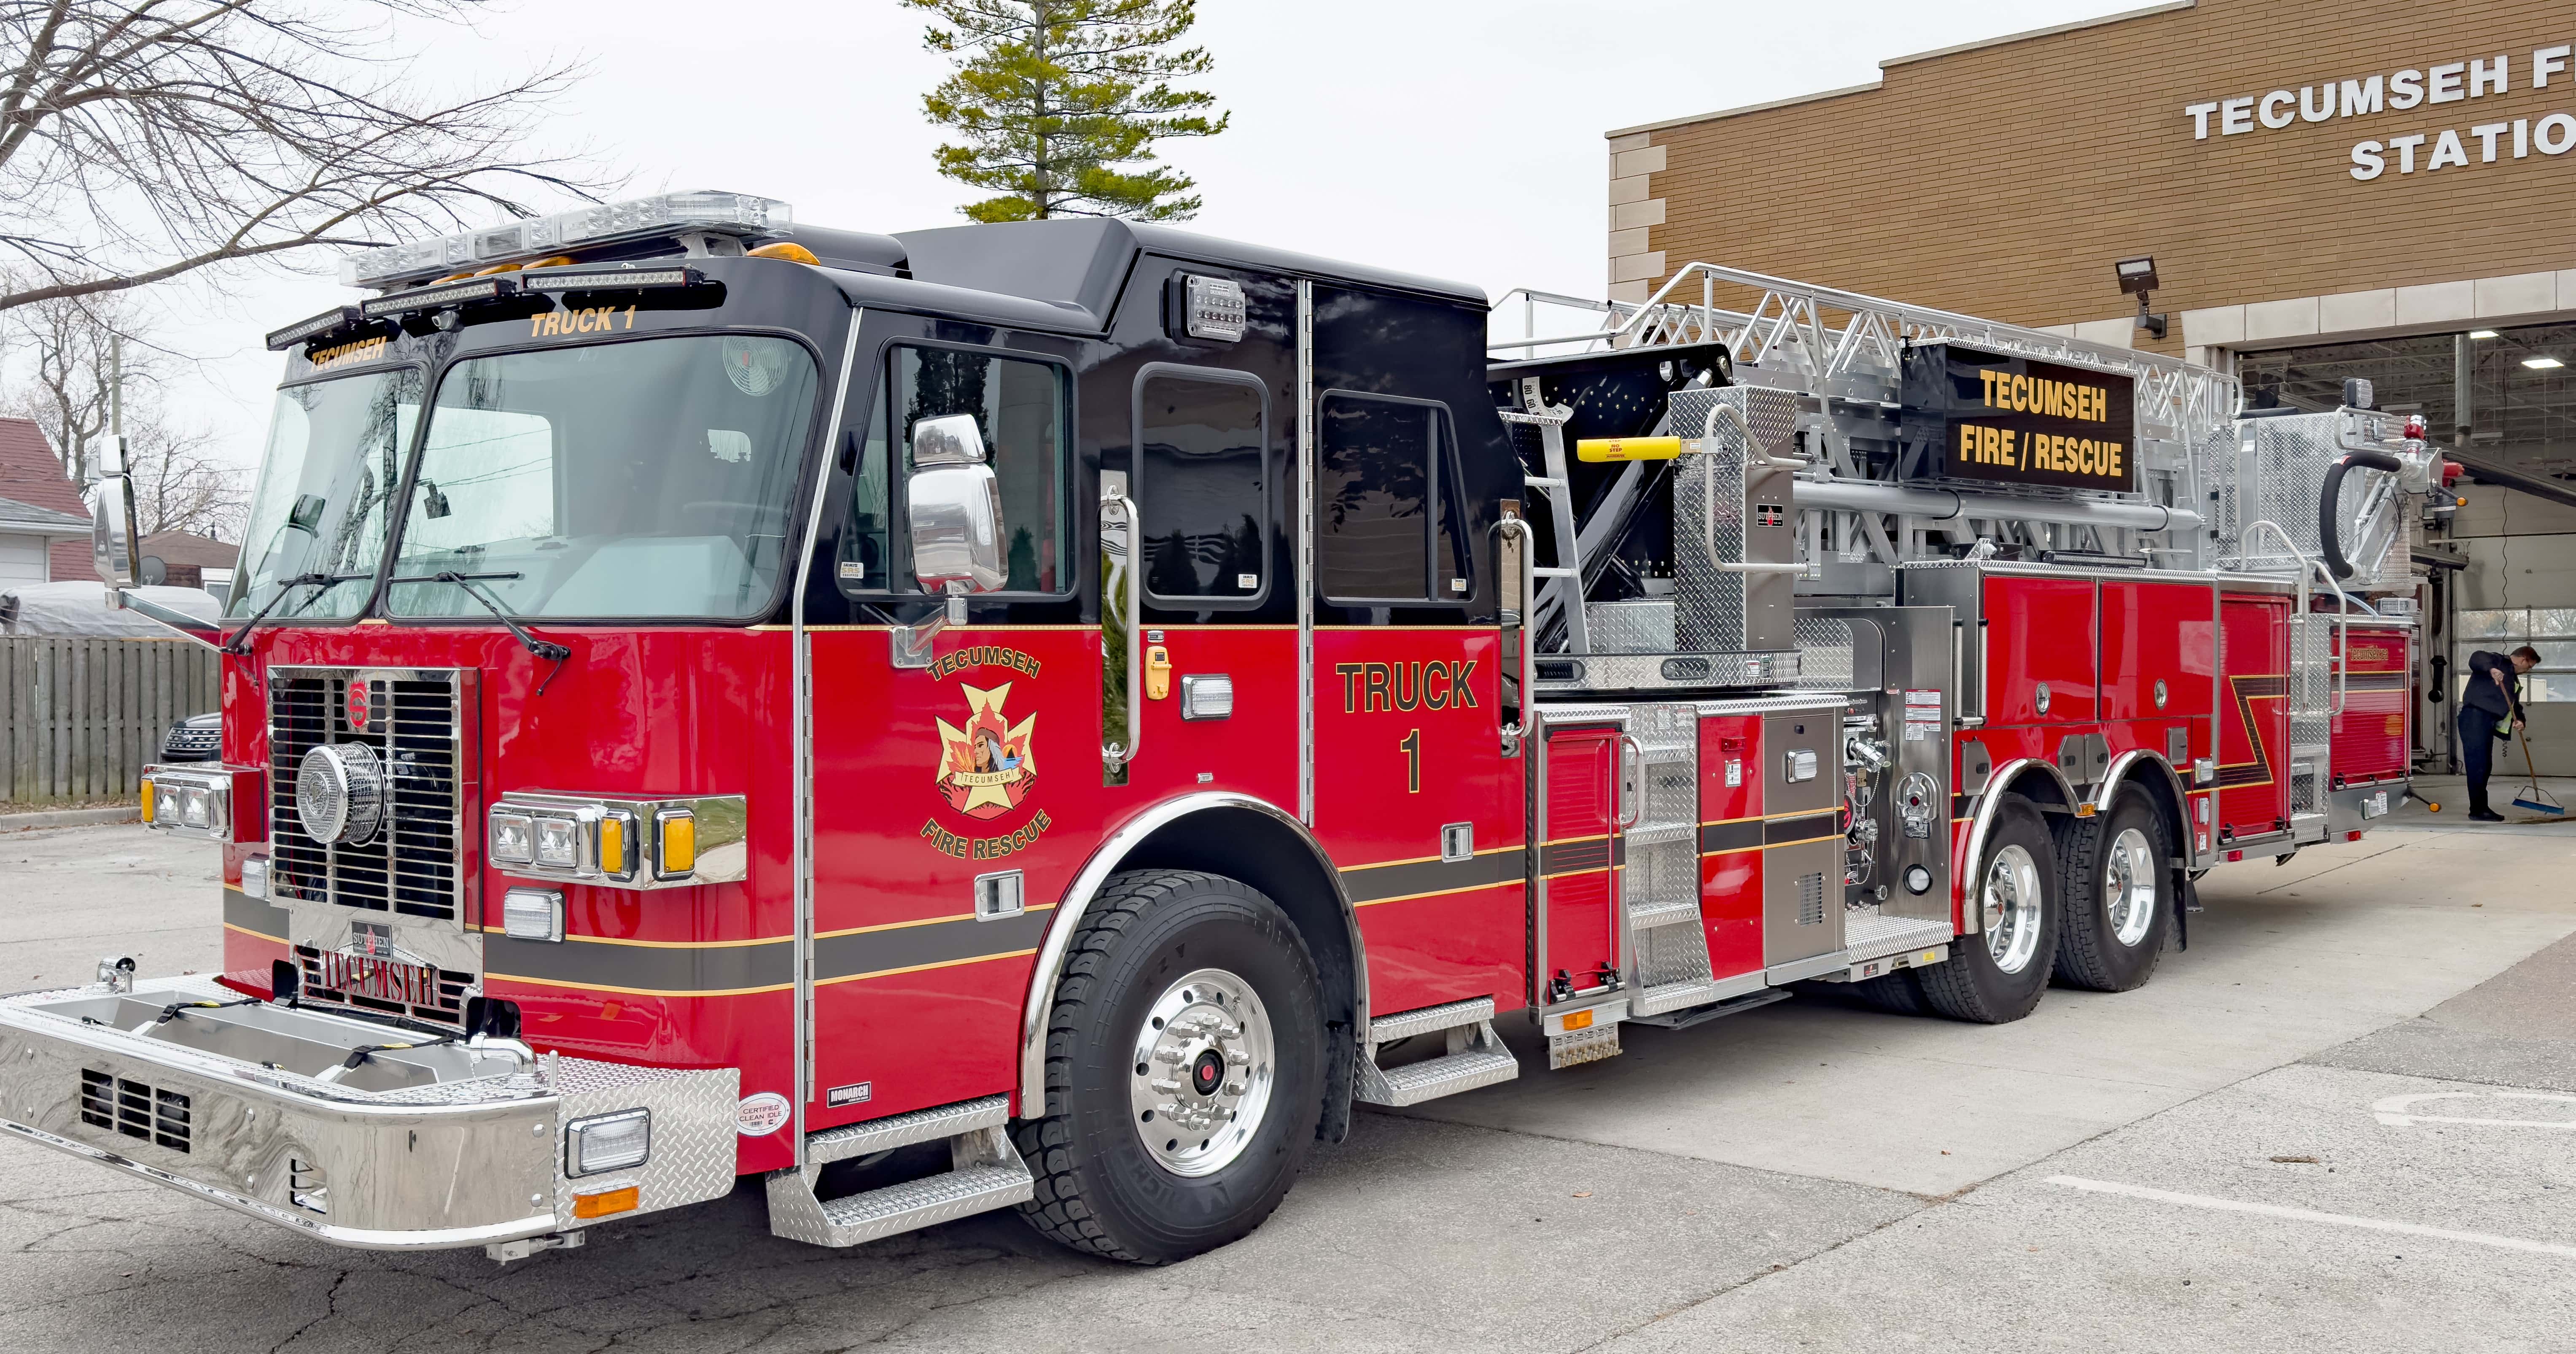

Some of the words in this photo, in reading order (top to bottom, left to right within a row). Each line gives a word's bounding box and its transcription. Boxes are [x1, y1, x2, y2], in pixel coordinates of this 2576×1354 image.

[2186, 54, 2509, 140] TECUMSEH
[2533, 43, 2576, 88] F
[2350, 113, 2576, 181] STATIO
[530, 306, 616, 337] TRUCK
[624, 305, 636, 329] 1
[310, 336, 387, 372] TECUMSEH
[1980, 370, 2106, 422] TECUMSEH
[1960, 424, 2015, 466] FIRE
[2021, 432, 2029, 471] /
[2035, 433, 2122, 477] RESCUE
[1758, 512, 1782, 521] SUTPHEN
[926, 646, 1041, 681] TECUMSEH
[1336, 660, 1478, 713] TRUCK
[964, 771, 1010, 783] TECUMSEH
[1400, 728, 1419, 793] 1
[920, 818, 968, 859] FIRE
[973, 809, 1052, 860] RESCUE
[353, 932, 389, 949] SUTPHEN
[322, 950, 435, 1006] TECUMSEH
[743, 1104, 779, 1114] CERTIFIED
[831, 1085, 868, 1102] MONARCH
